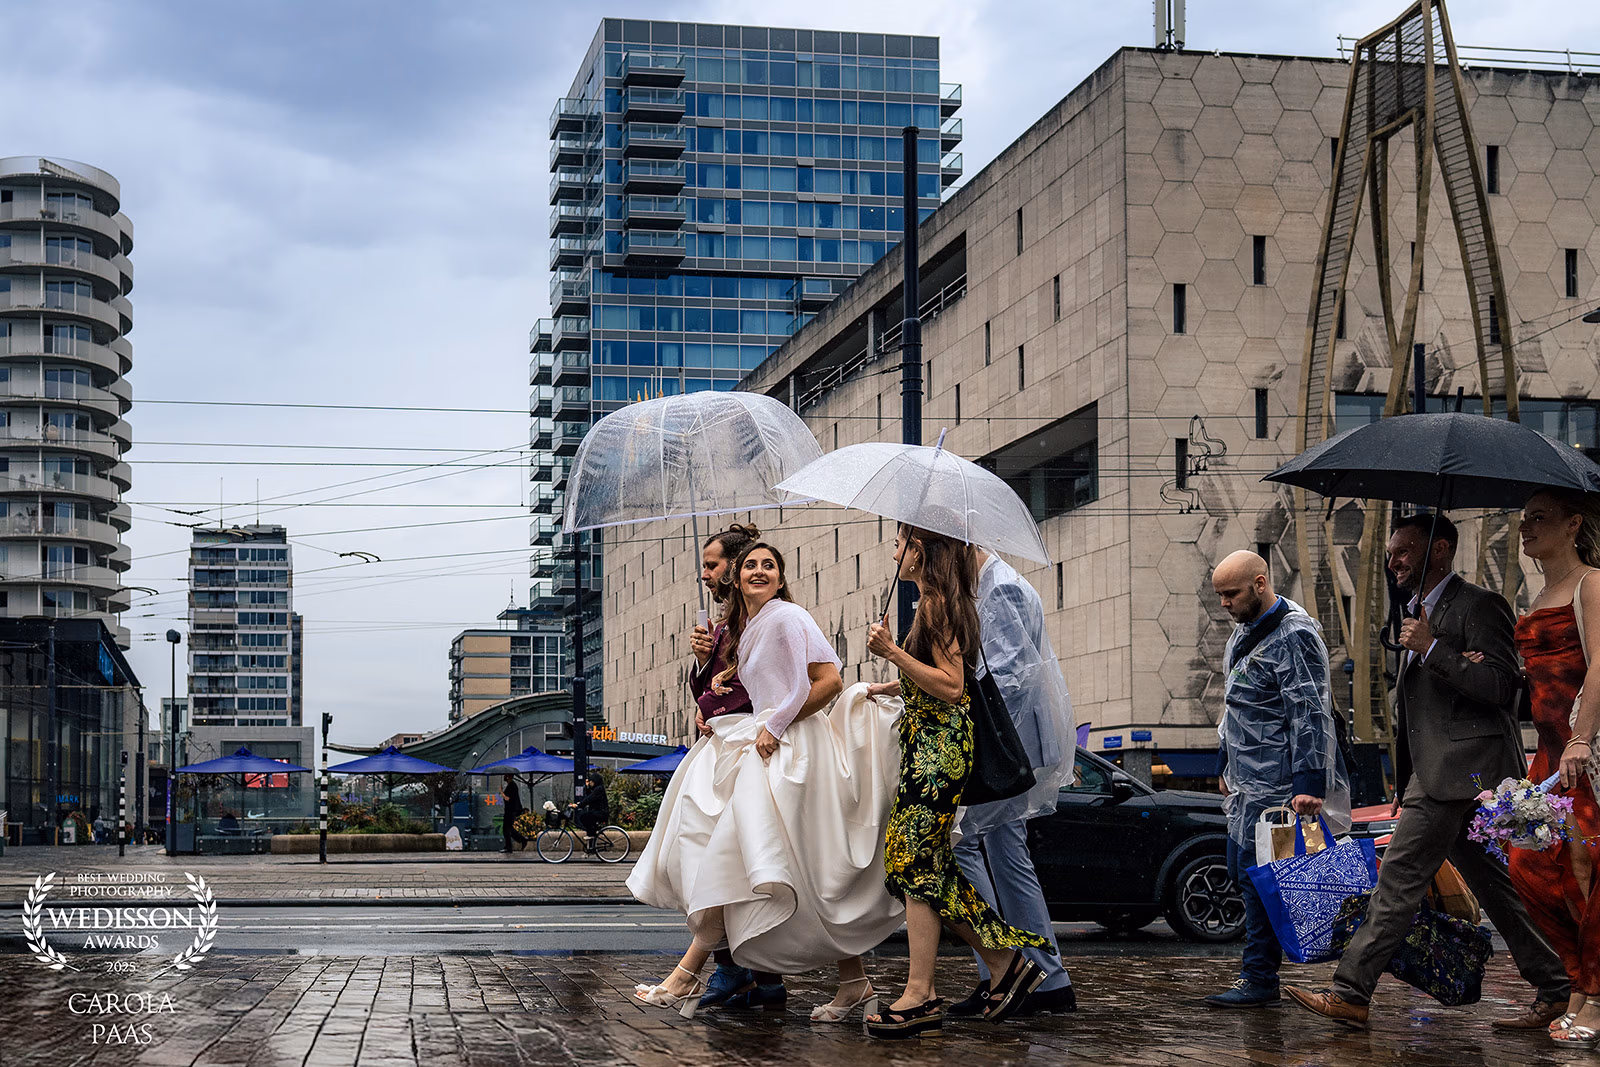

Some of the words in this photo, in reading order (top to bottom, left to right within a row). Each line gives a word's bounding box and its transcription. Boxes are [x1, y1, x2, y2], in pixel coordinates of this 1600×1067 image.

[592, 725, 617, 740] kiki
[620, 731, 667, 744] BURGER
[1279, 882, 1319, 890] MASCOLORI
[1320, 884, 1359, 893] MASCOLORI
